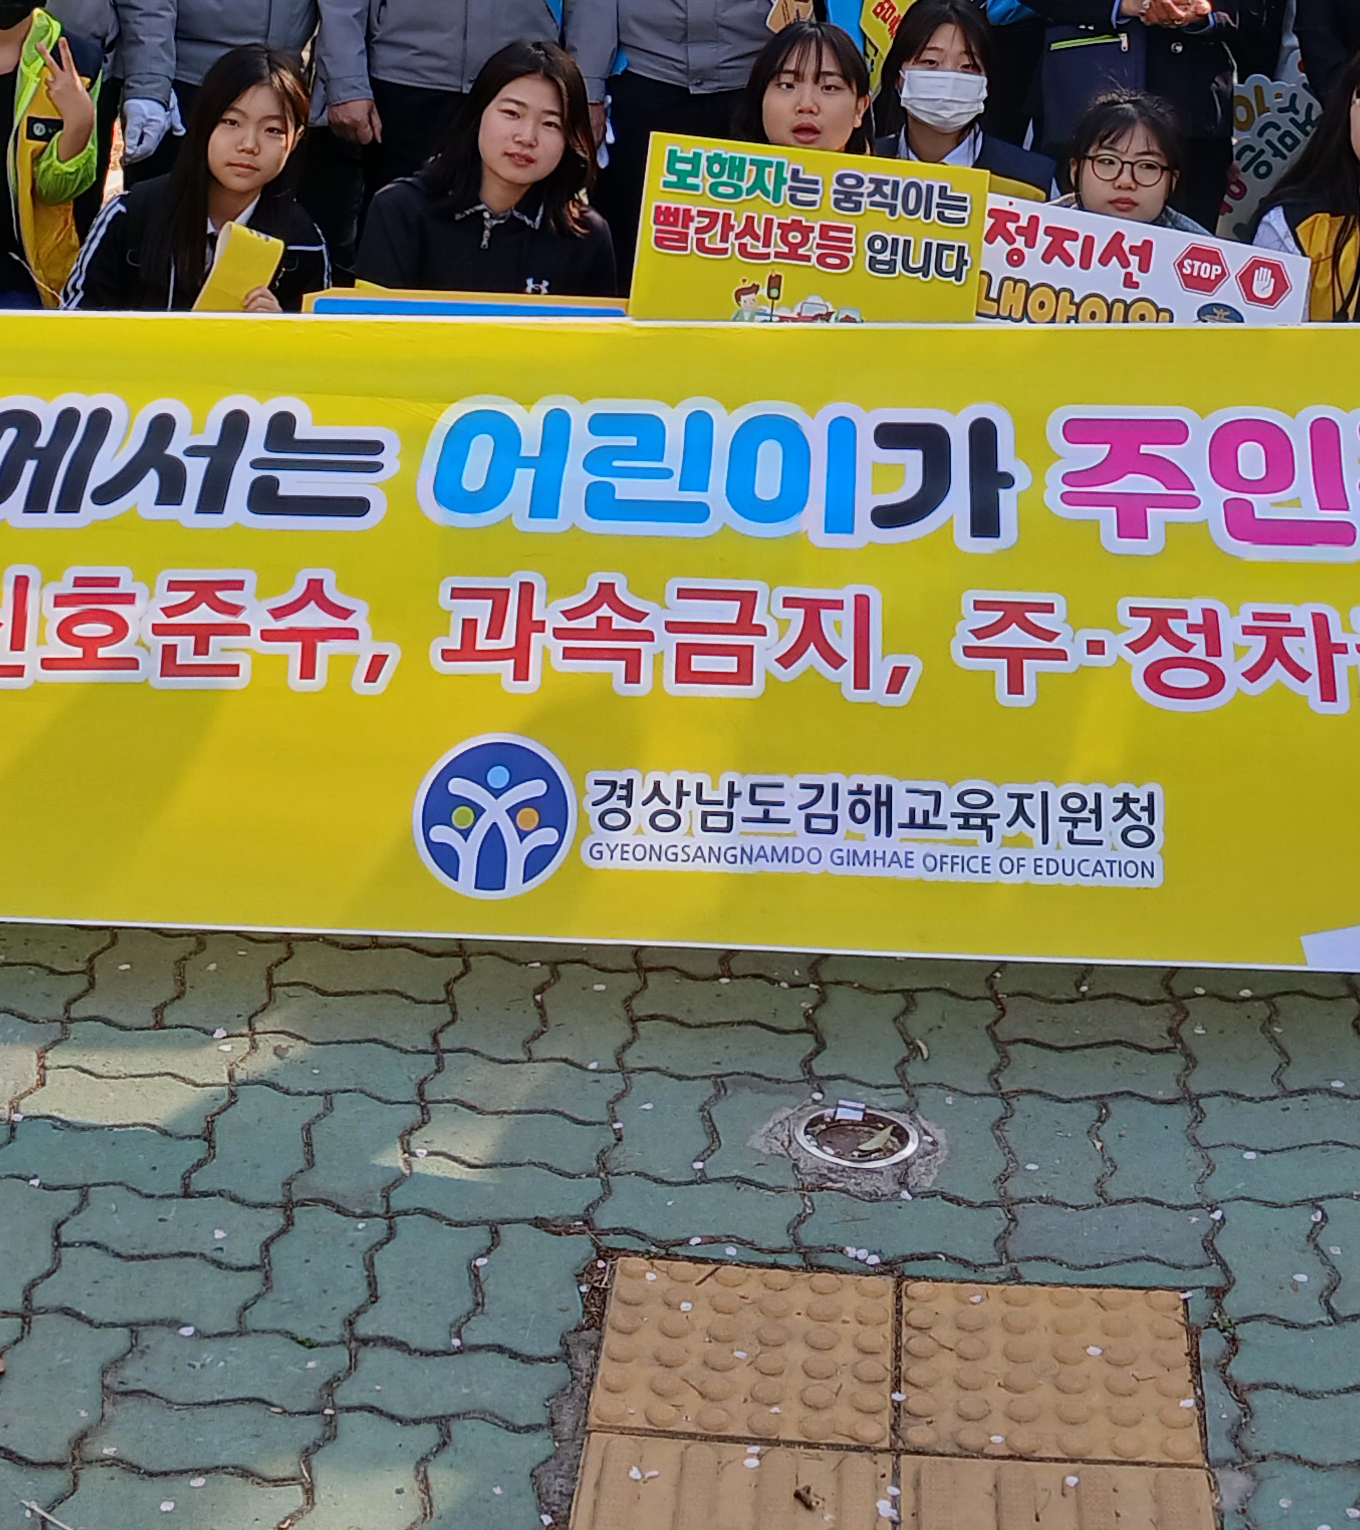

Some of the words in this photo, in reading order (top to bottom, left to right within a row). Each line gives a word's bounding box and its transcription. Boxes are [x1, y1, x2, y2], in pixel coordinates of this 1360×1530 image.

[660, 147, 823, 208] 보행자는
[832, 170, 970, 226] 움직이는
[651, 203, 857, 272] 빨간신호등
[866, 233, 970, 284] 입니다
[984, 207, 1154, 290] 정지선
[1181, 257, 1223, 281] STOP
[442, 407, 1015, 541] 어린이가
[441, 577, 914, 699] 과속금지,
[590, 775, 1158, 849] 경상남도김해교육지원청
[588, 842, 824, 868] GYEONGSANGNAMDO
[830, 846, 915, 870] GIMHAE
[921, 851, 993, 875] OFFICE
[999, 855, 1028, 877] OF
[1032, 857, 1156, 880] EDUCATION
